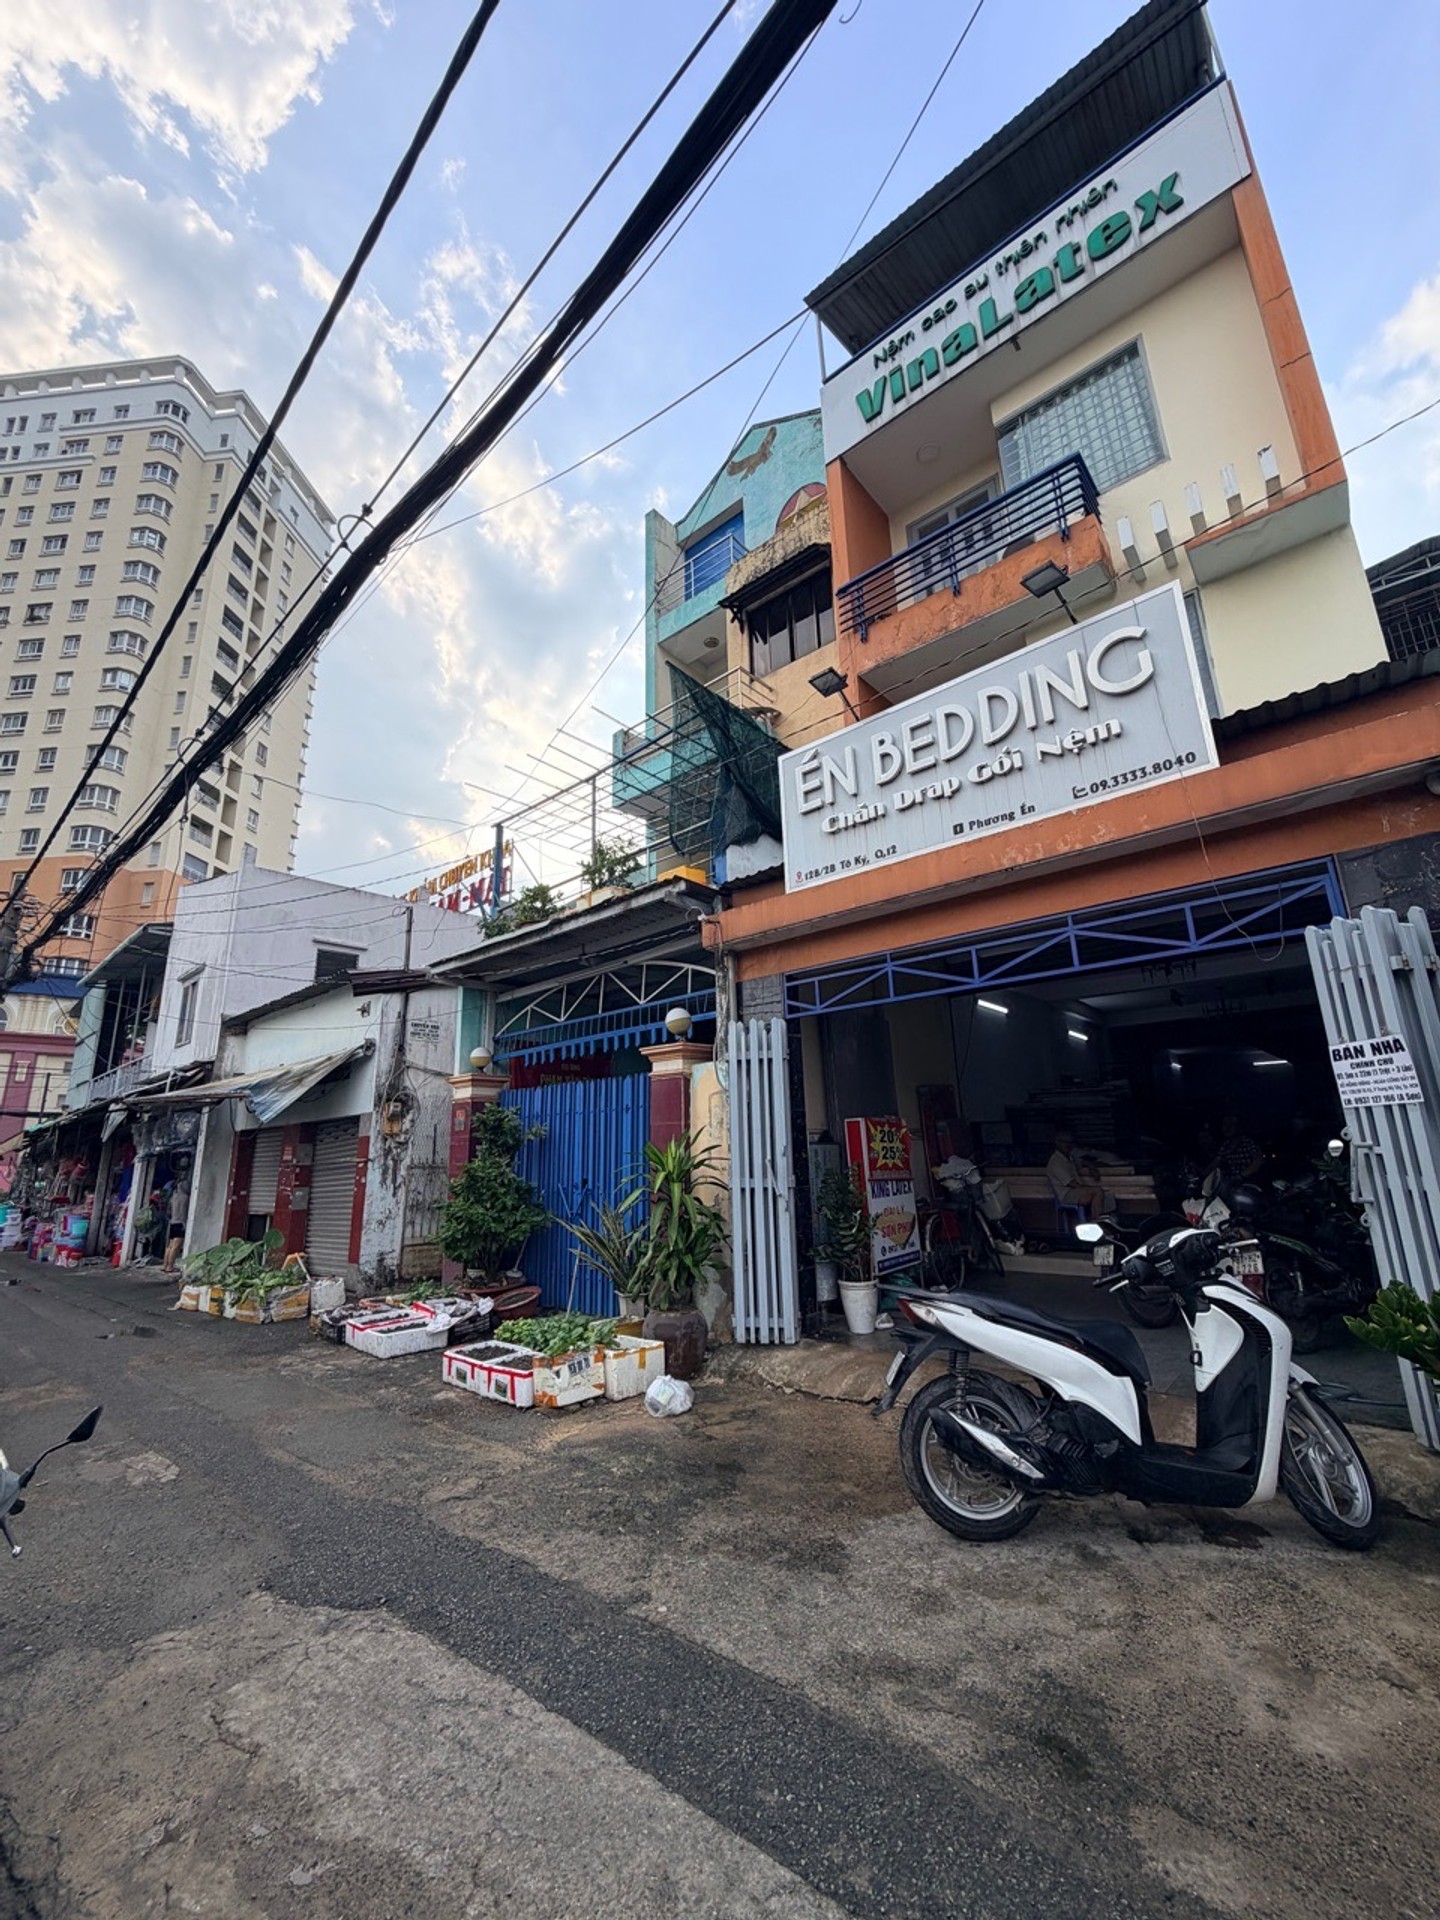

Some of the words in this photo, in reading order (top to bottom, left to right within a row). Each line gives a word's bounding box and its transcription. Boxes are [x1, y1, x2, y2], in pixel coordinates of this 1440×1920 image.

[921, 297, 958, 332] cao
[963, 273, 989, 299] su
[995, 232, 1049, 276] thiên
[1055, 178, 1119, 234] nhiên
[794, 748, 859, 816] ÉN
[870, 625, 1156, 788] BEDDING
[893, 775, 963, 813] Drap
[966, 743, 1026, 786] Gối
[1035, 717, 1124, 764] Nệm
[968, 811, 1016, 831] Phương
[1332, 1044, 1366, 1062] BÁN
[1370, 1036, 1406, 1057] NHÀ
